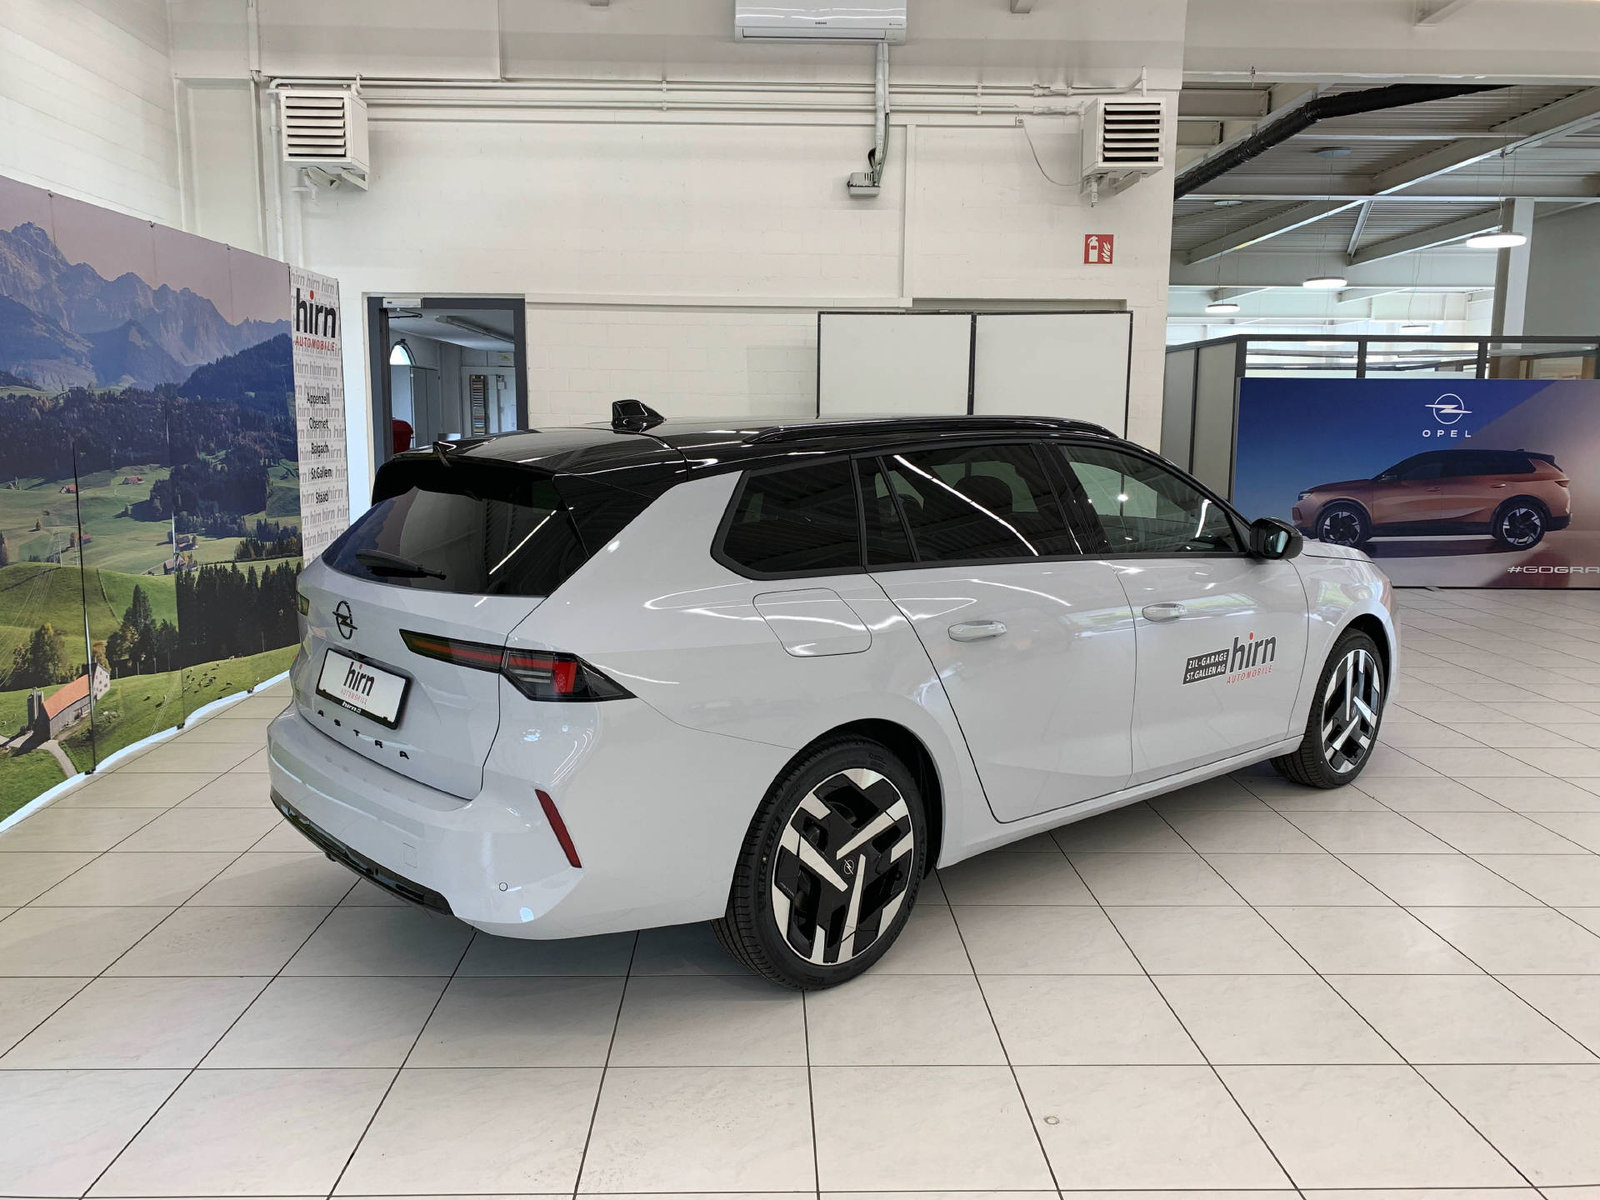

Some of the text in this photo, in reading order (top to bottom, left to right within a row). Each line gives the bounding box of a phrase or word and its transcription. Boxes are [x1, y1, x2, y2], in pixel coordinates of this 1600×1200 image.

[296, 287, 336, 338] hirn
[295, 336, 335, 352] AUTOMOBILE
[295, 358, 338, 377] hirn hirn hirn
[306, 392, 331, 407] Appenzell
[1422, 429, 1472, 438] OPEL
[311, 441, 329, 458] Balgach
[315, 490, 329, 504] Staad
[1507, 565, 1600, 574] #GOGRA
[1188, 652, 1228, 669] ZIL-GARAGE
[1229, 632, 1277, 673] hirn
[343, 661, 375, 696] hirn
[1186, 664, 1226, 681] ST.GALLEN AG
[1226, 665, 1273, 685] AUTOMOBILE
[317, 709, 410, 760] ASTRA
